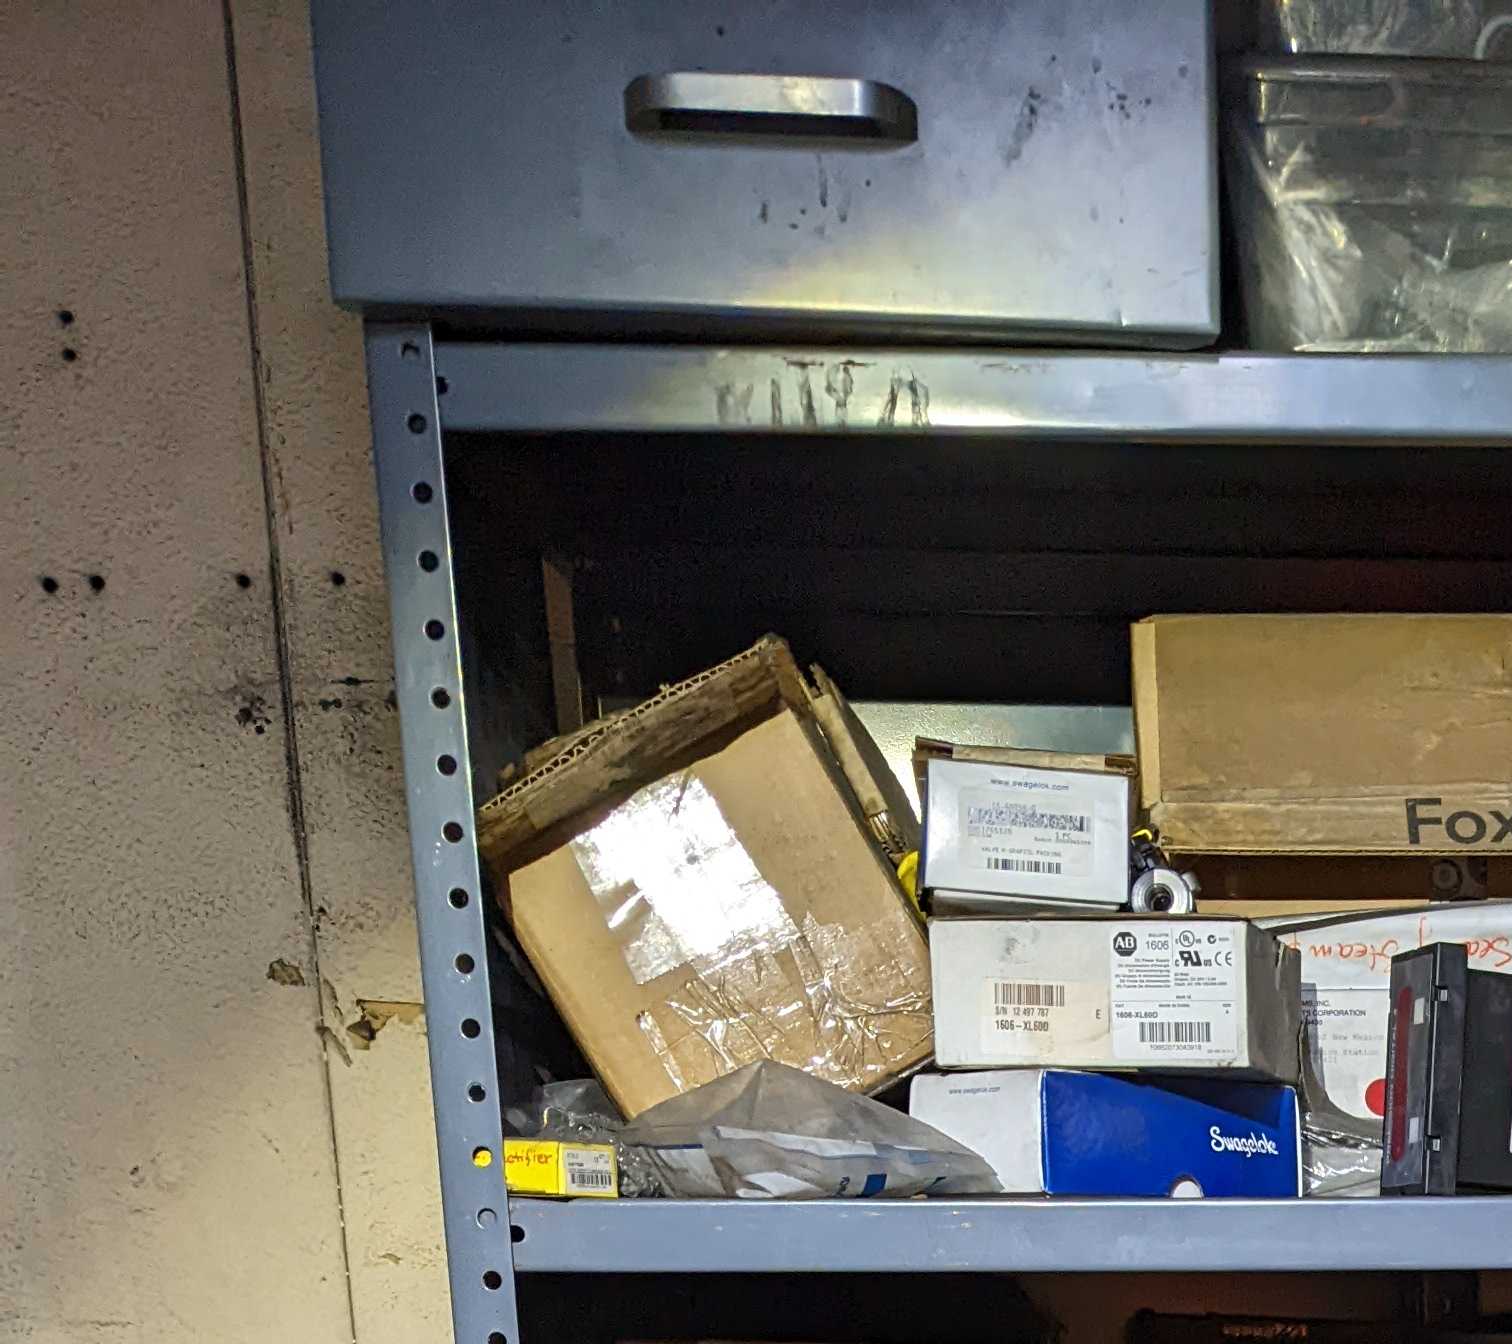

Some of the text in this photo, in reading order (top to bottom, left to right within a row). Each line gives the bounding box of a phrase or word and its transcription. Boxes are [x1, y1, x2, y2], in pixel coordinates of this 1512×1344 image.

[1115, 936, 1134, 949] AB
[1146, 940, 1169, 950] 1606
[1095, 1009, 1101, 1020] E
[1210, 1126, 1279, 1158] Swagelok
